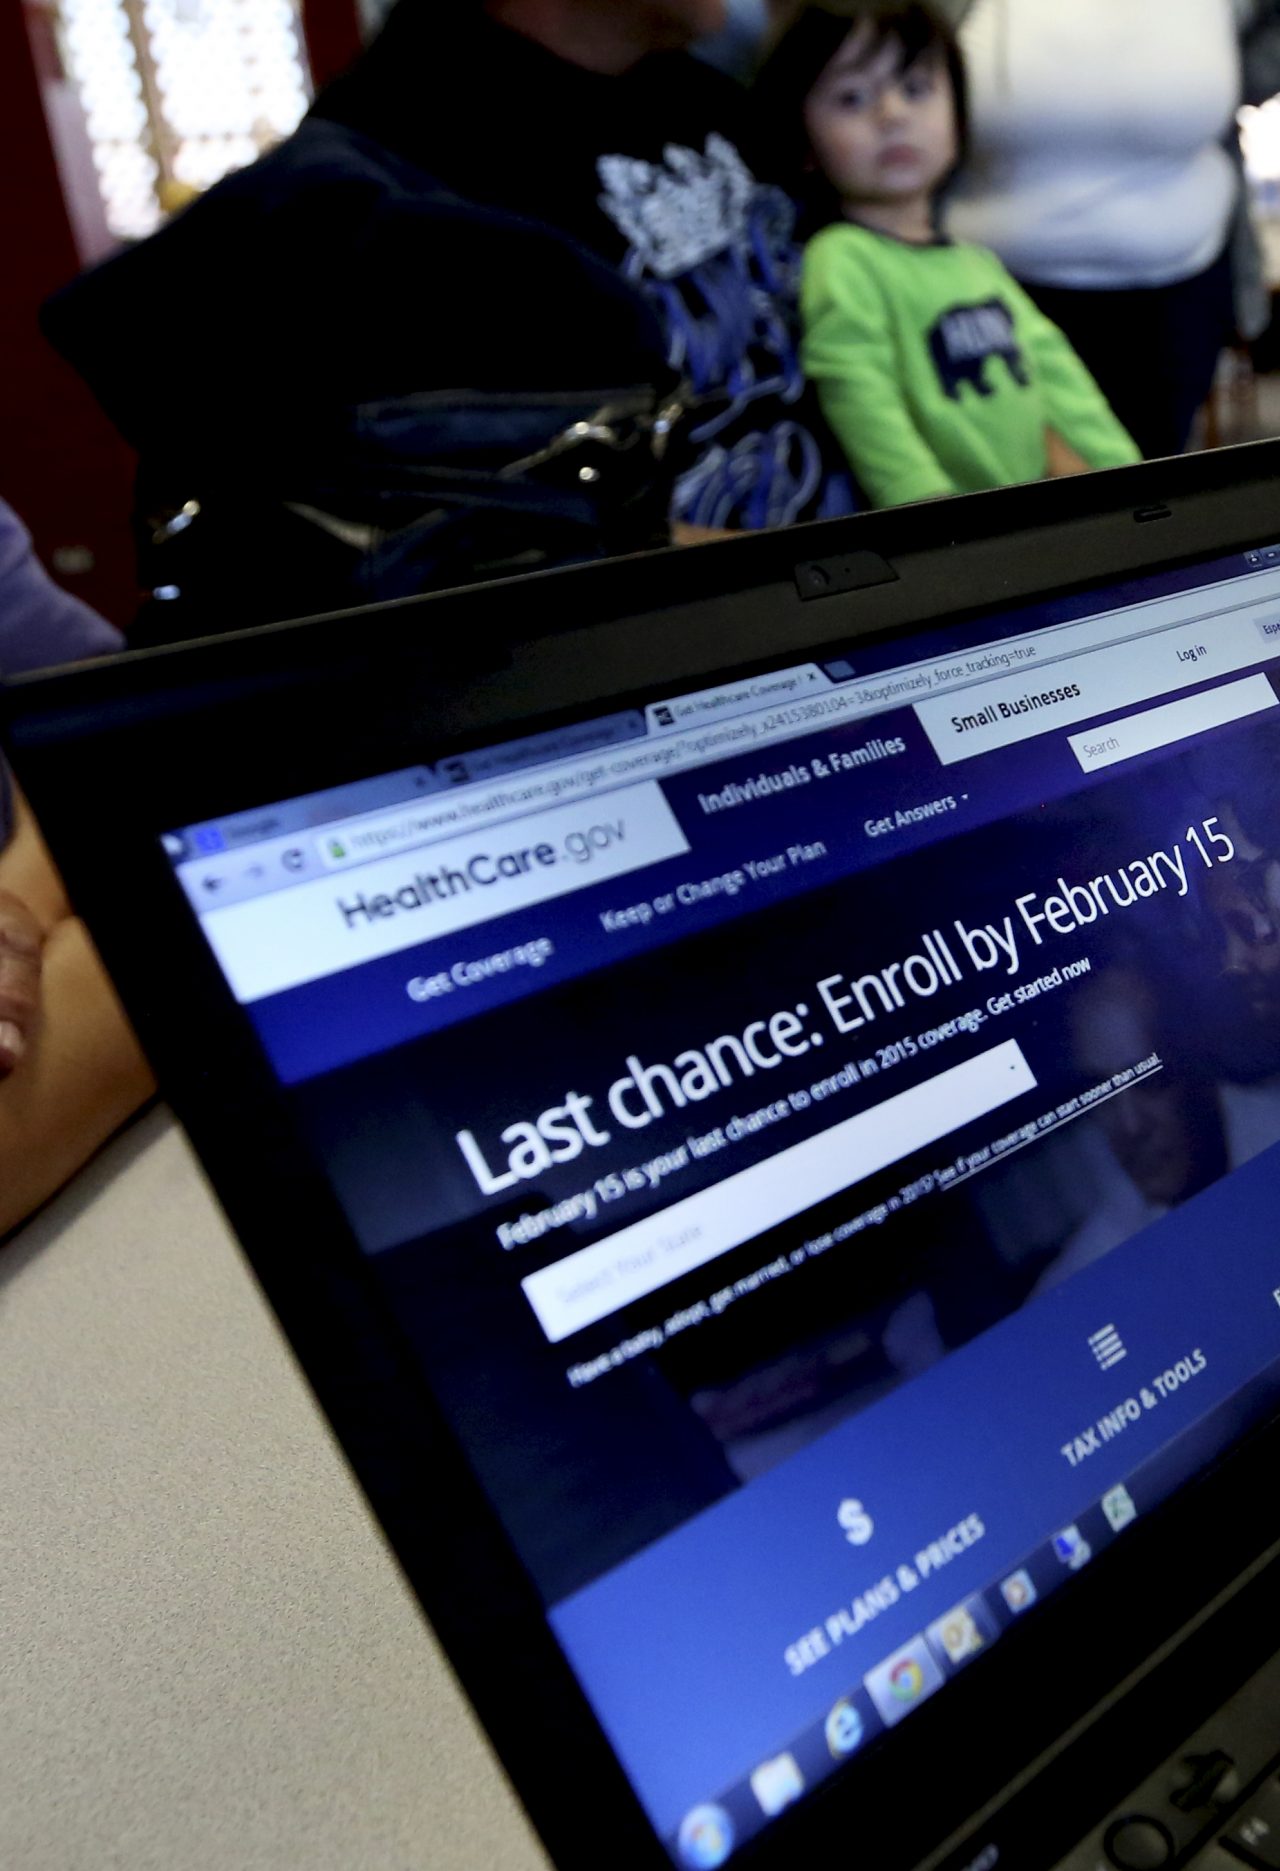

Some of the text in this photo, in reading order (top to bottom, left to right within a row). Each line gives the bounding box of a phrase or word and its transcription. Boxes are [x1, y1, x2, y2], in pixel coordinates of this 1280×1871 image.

[1176, 643, 1207, 664] Log in
[951, 682, 1081, 734] Small Businesses
[1082, 736, 1120, 759] Search
[697, 735, 907, 815] Individuals & Families
[863, 793, 957, 838] Get Answers
[338, 819, 626, 930] HealthCare.gov
[601, 840, 827, 933] Keep or Change Your Plan
[406, 937, 554, 1001] Get Coverage
[456, 817, 1235, 1195] Last chance: Enroll by February 15
[496, 956, 1092, 1251] February 15 is your last chance to enroll in 2015 coverage. Get started now
[832, 1201, 889, 1242] coverage
[886, 1194, 901, 1213] in
[932, 1165, 957, 1185] See
[964, 1146, 993, 1171] your
[990, 1121, 1039, 1156] coverage
[1036, 1111, 1058, 1130] can
[1055, 1096, 1081, 1119] start
[1078, 1080, 1114, 1109] sooner
[1110, 1066, 1135, 1089] than
[1132, 1052, 1163, 1076] usual.
[1061, 1347, 1208, 1467] TAX INFO & TOOLS
[784, 1512, 986, 1676] SEE PLANS & PRICES
